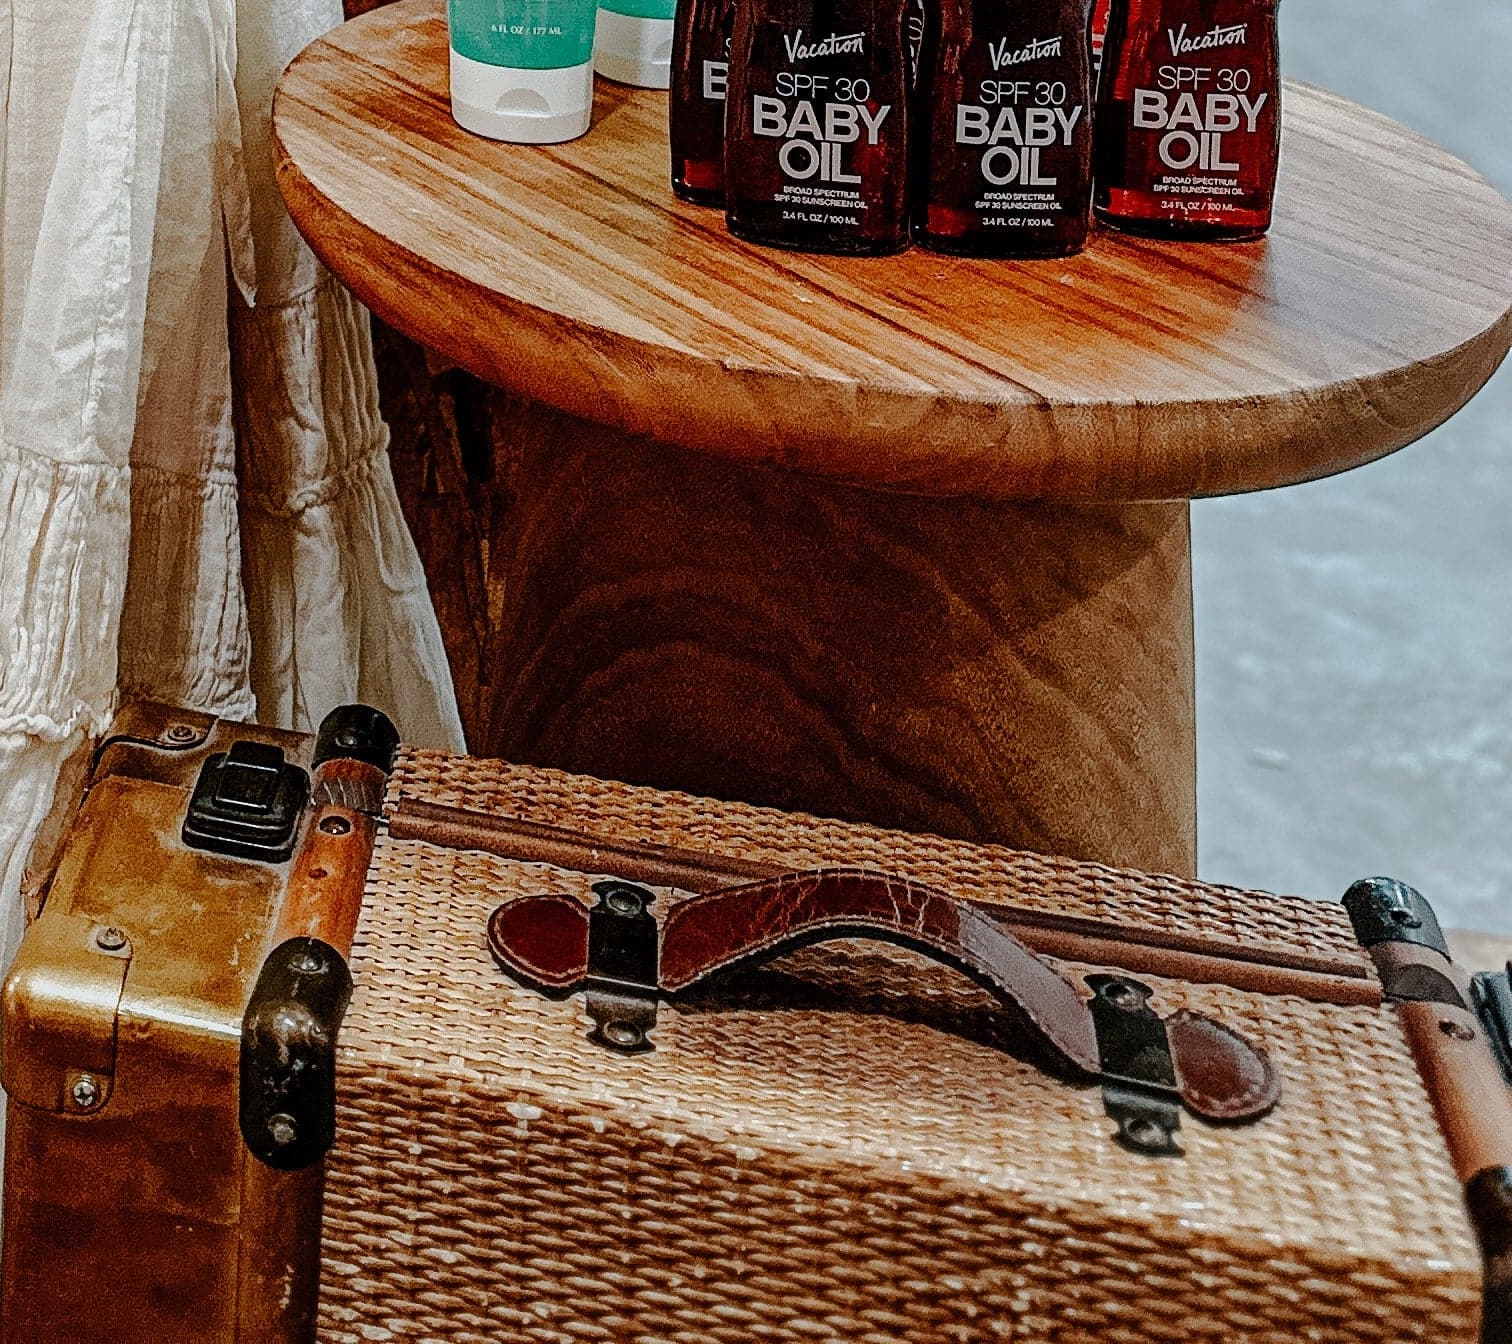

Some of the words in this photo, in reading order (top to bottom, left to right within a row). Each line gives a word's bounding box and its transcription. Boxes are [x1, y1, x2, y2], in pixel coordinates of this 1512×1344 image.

[510, 25, 524, 35] OZ
[1167, 23, 1247, 57] Vacation
[784, 29, 865, 63] Vacation
[988, 36, 1062, 71] Vacation
[776, 72, 829, 98] SPF
[835, 78, 870, 102] 30
[1157, 66, 1212, 90] SPF
[1217, 68, 1251, 92] 30
[979, 80, 1031, 105] SPF
[1034, 81, 1066, 105] 30
[754, 95, 891, 145] BABY
[1133, 88, 1268, 133] BABY
[955, 104, 1083, 146] BABY
[779, 139, 862, 184] OIL
[1158, 130, 1240, 171] OIL
[981, 145, 1057, 186] OIL
[783, 185, 813, 196] BROAD
[813, 188, 860, 200] SPECTRUM
[1162, 175, 1192, 185] BROAD
[1192, 177, 1238, 187] SPECTRUM
[1181, 185, 1231, 194] SUNSCREEN
[1231, 187, 1244, 196] OIL
[802, 196, 853, 208] SUNSCREEN
[854, 200, 868, 210] OIL
[983, 192, 1012, 201] BROAD
[1013, 193, 1055, 201] SPECTRUM
[1002, 202, 1049, 210] SUNSCREEN
[1050, 202, 1063, 210] OIL
[1188, 201, 1201, 210] OZ
[1207, 201, 1221, 210] 100
[810, 213, 823, 223] OZ
[830, 215, 844, 224] 100
[1008, 218, 1021, 227] OZ
[1028, 218, 1041, 227] 100
